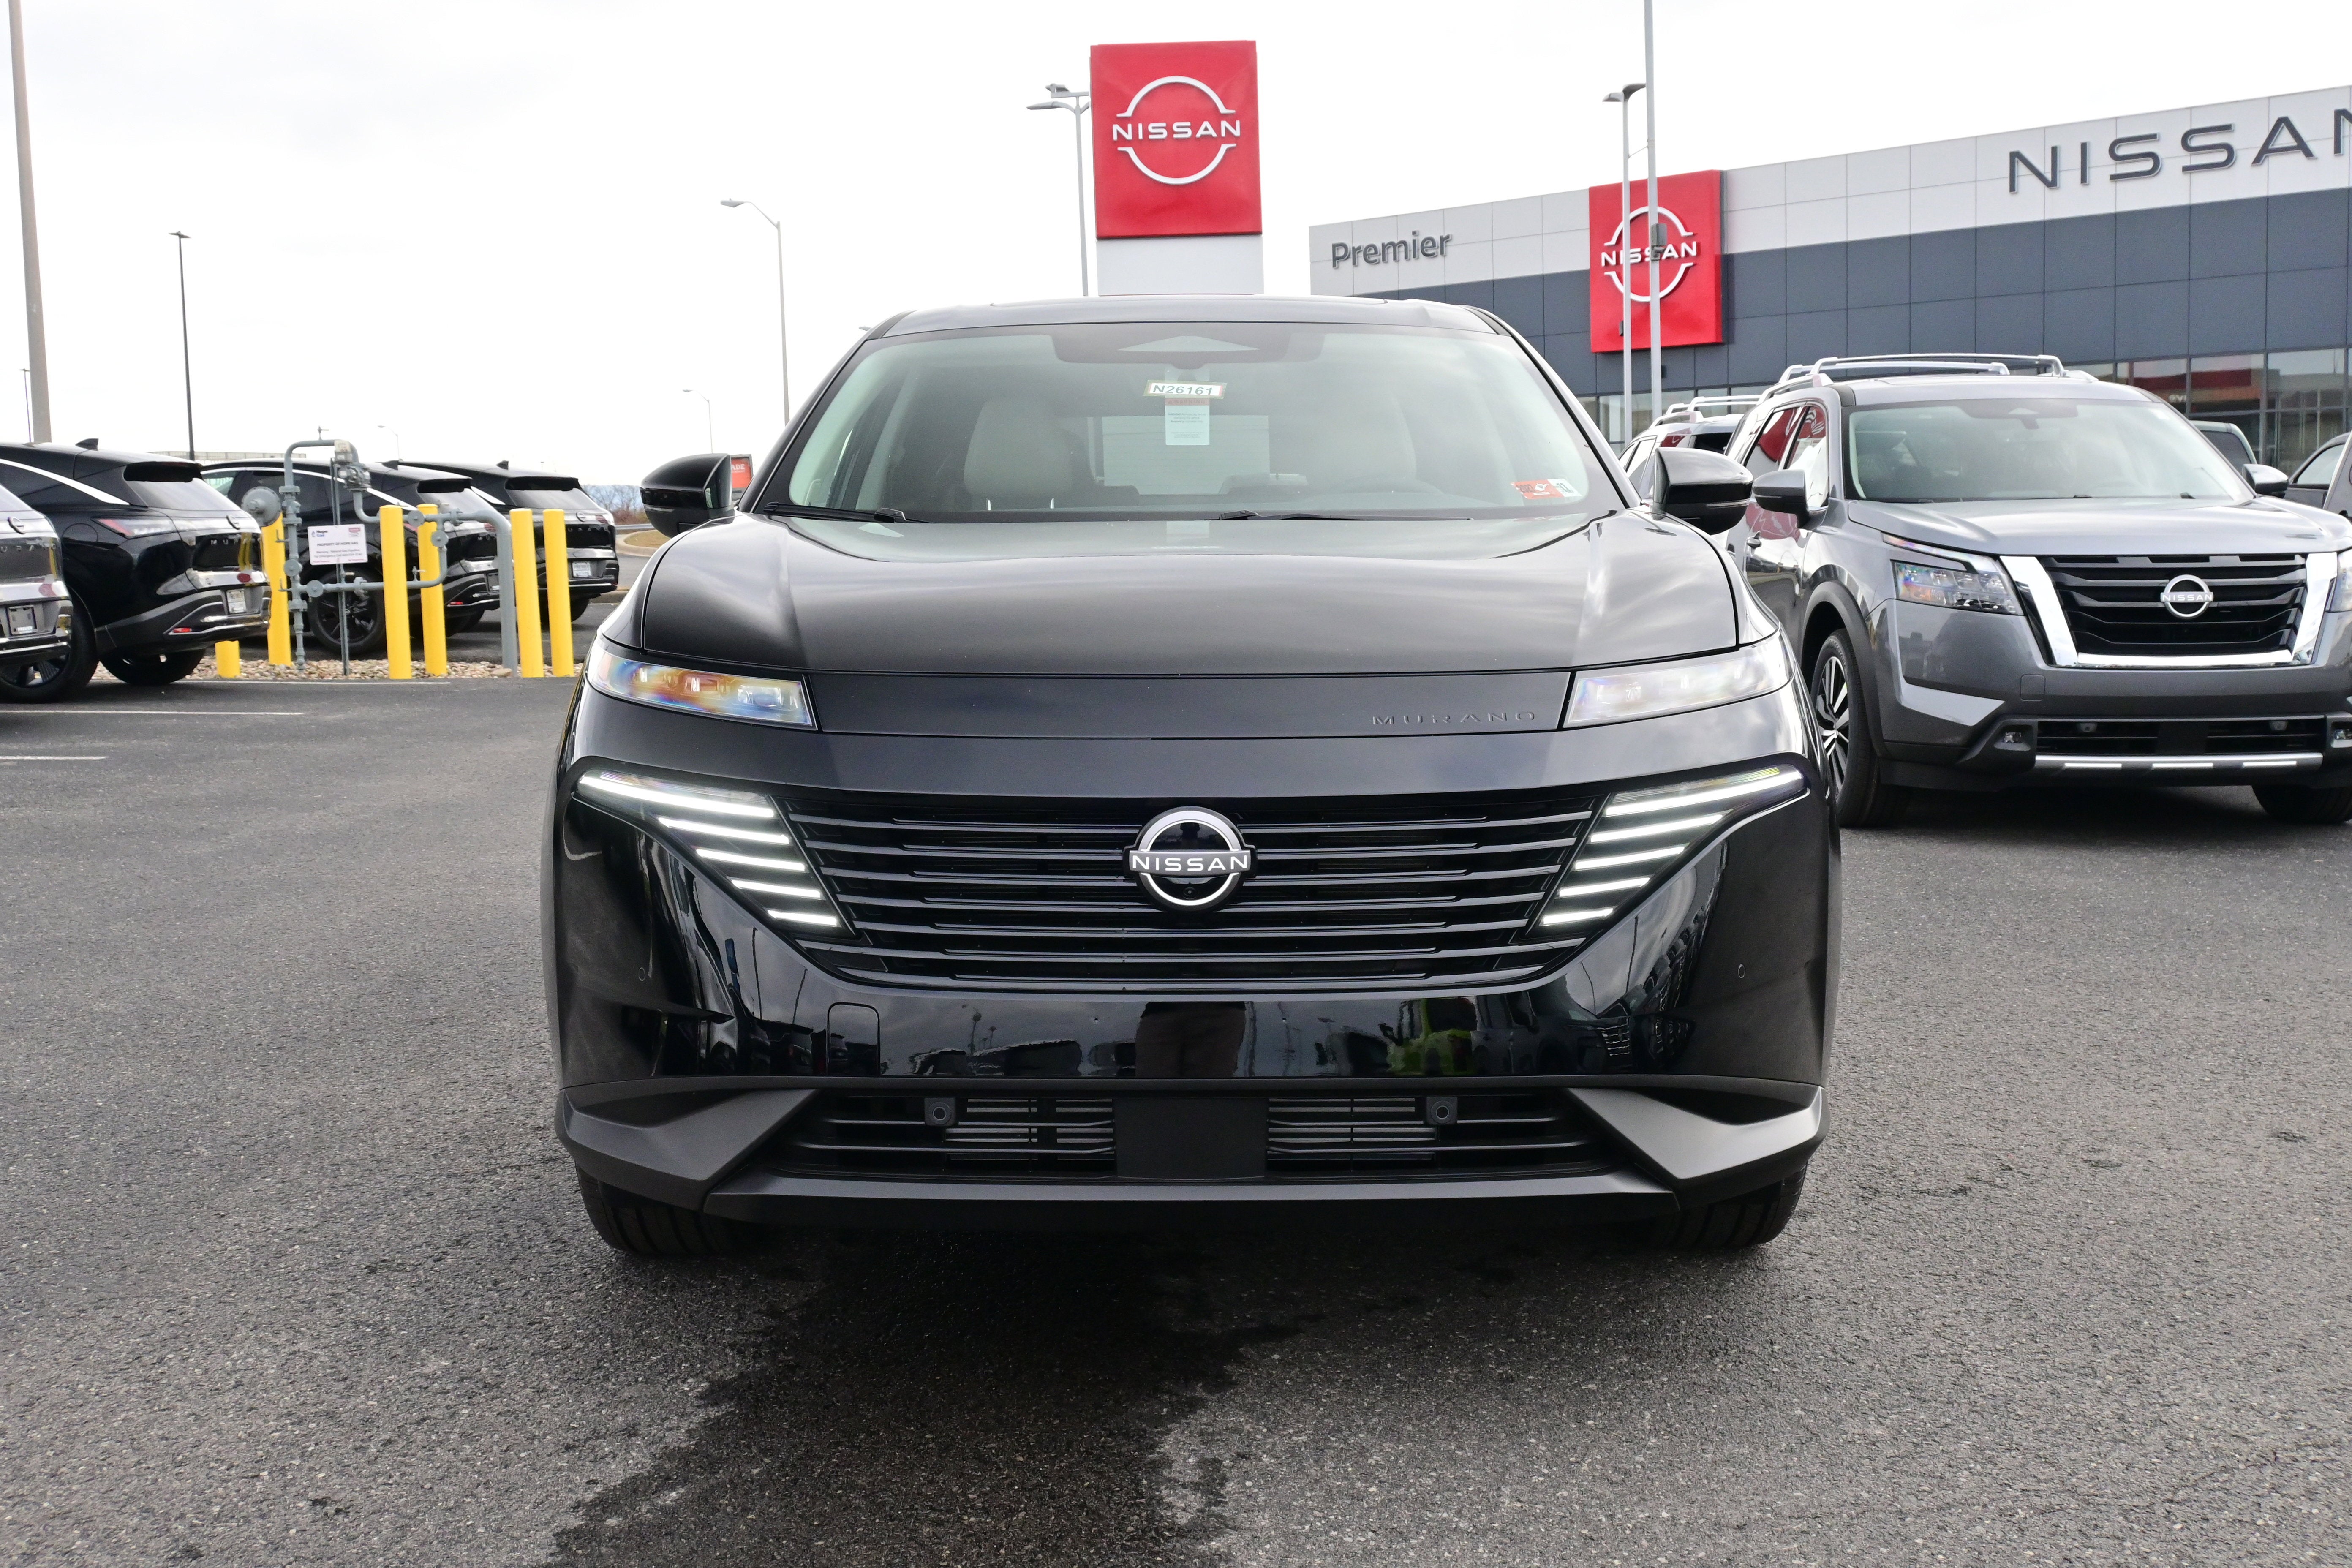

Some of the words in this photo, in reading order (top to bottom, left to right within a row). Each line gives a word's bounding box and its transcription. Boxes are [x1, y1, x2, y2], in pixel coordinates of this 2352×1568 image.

[1112, 120, 1241, 141] NISSAN
[1332, 230, 1452, 268] Premier
[1153, 384, 1213, 395] N26161
[1372, 711, 1535, 725] MURANO
[1132, 855, 1247, 871] NISSAN
